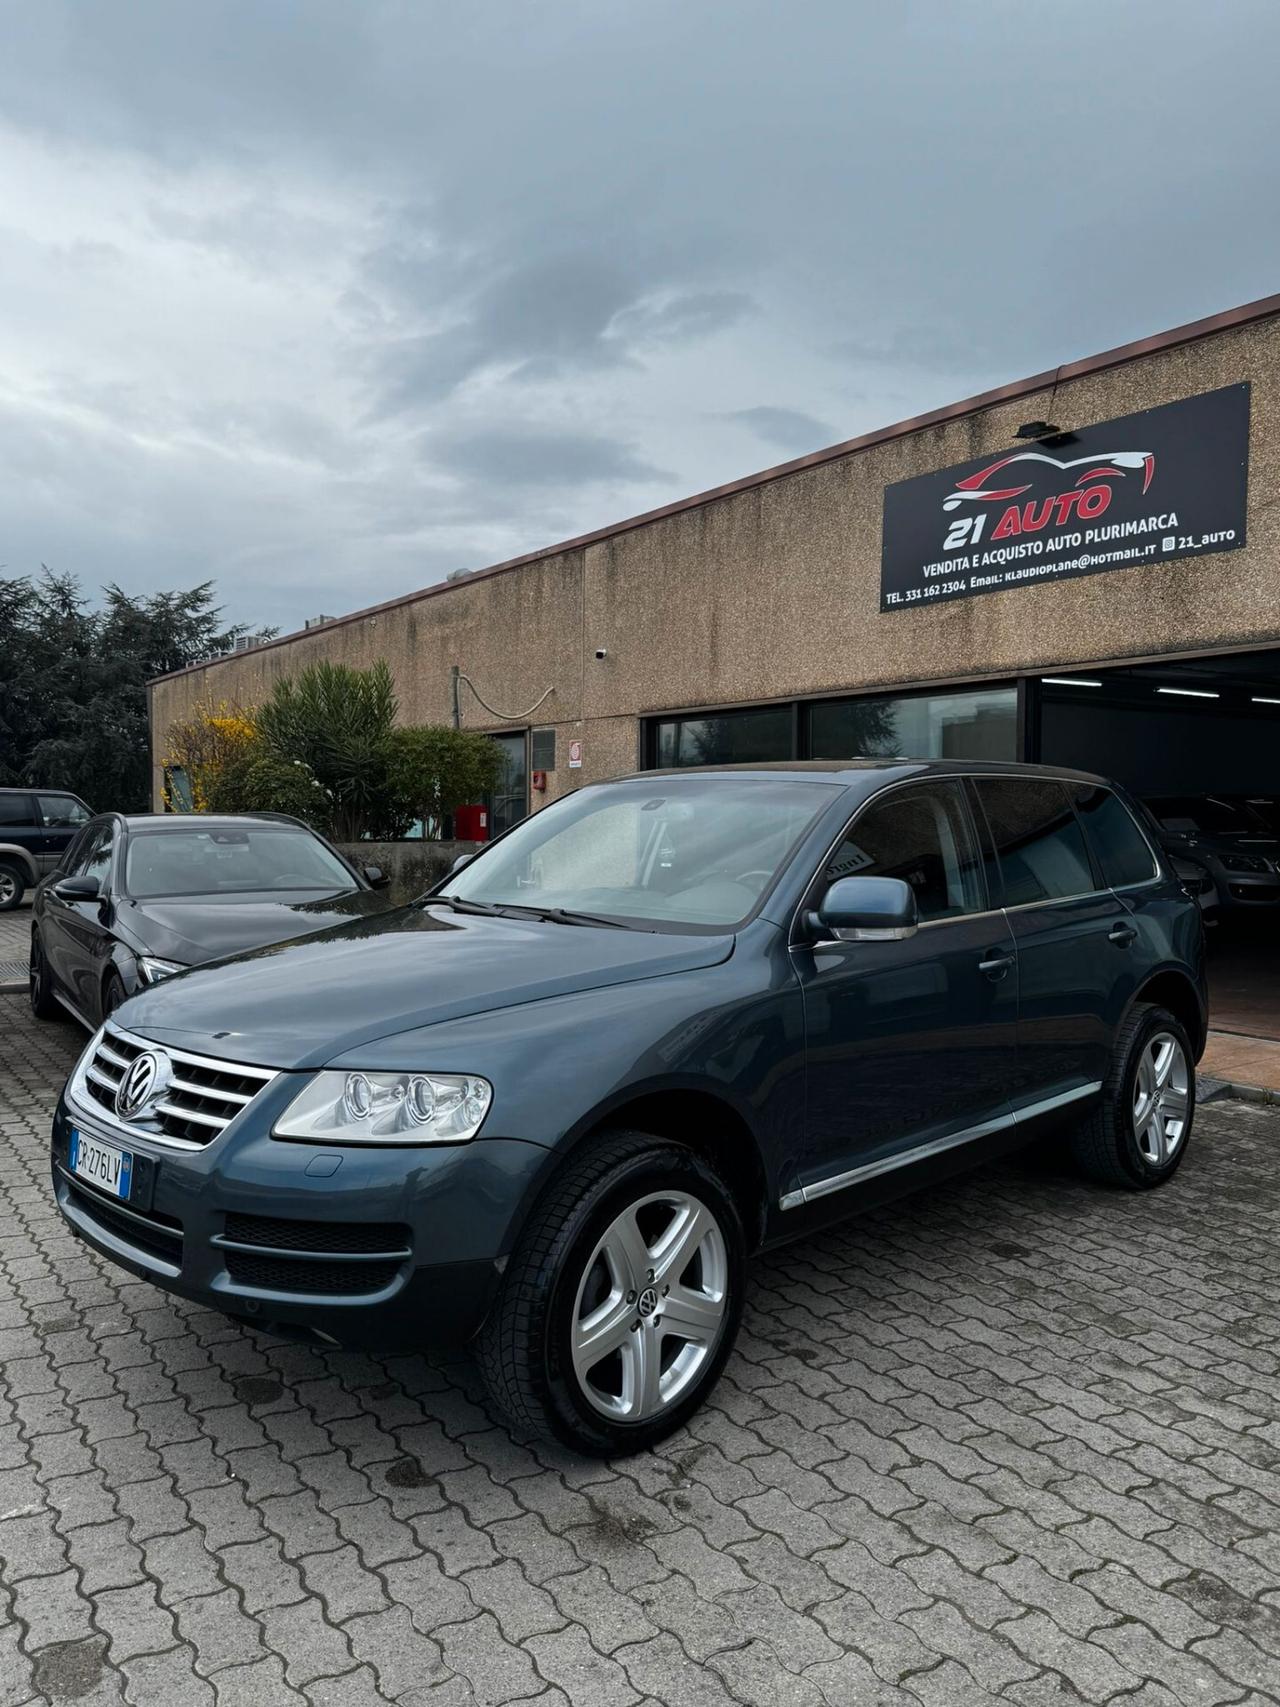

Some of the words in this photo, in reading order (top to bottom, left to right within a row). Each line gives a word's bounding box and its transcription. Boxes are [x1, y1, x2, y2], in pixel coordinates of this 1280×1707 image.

[923, 556, 970, 578] VENDITA
[973, 554, 979, 567] E
[982, 541, 1043, 565] ACQUISTO
[1045, 532, 1082, 553] AUTO
[1085, 512, 1178, 544] PLURIMARCA
[943, 514, 987, 550] 21
[990, 484, 1112, 540] AUTO
[886, 593, 904, 604] TEL.
[906, 588, 922, 601] 331
[923, 585, 940, 598] 162
[942, 582, 966, 594] 2304
